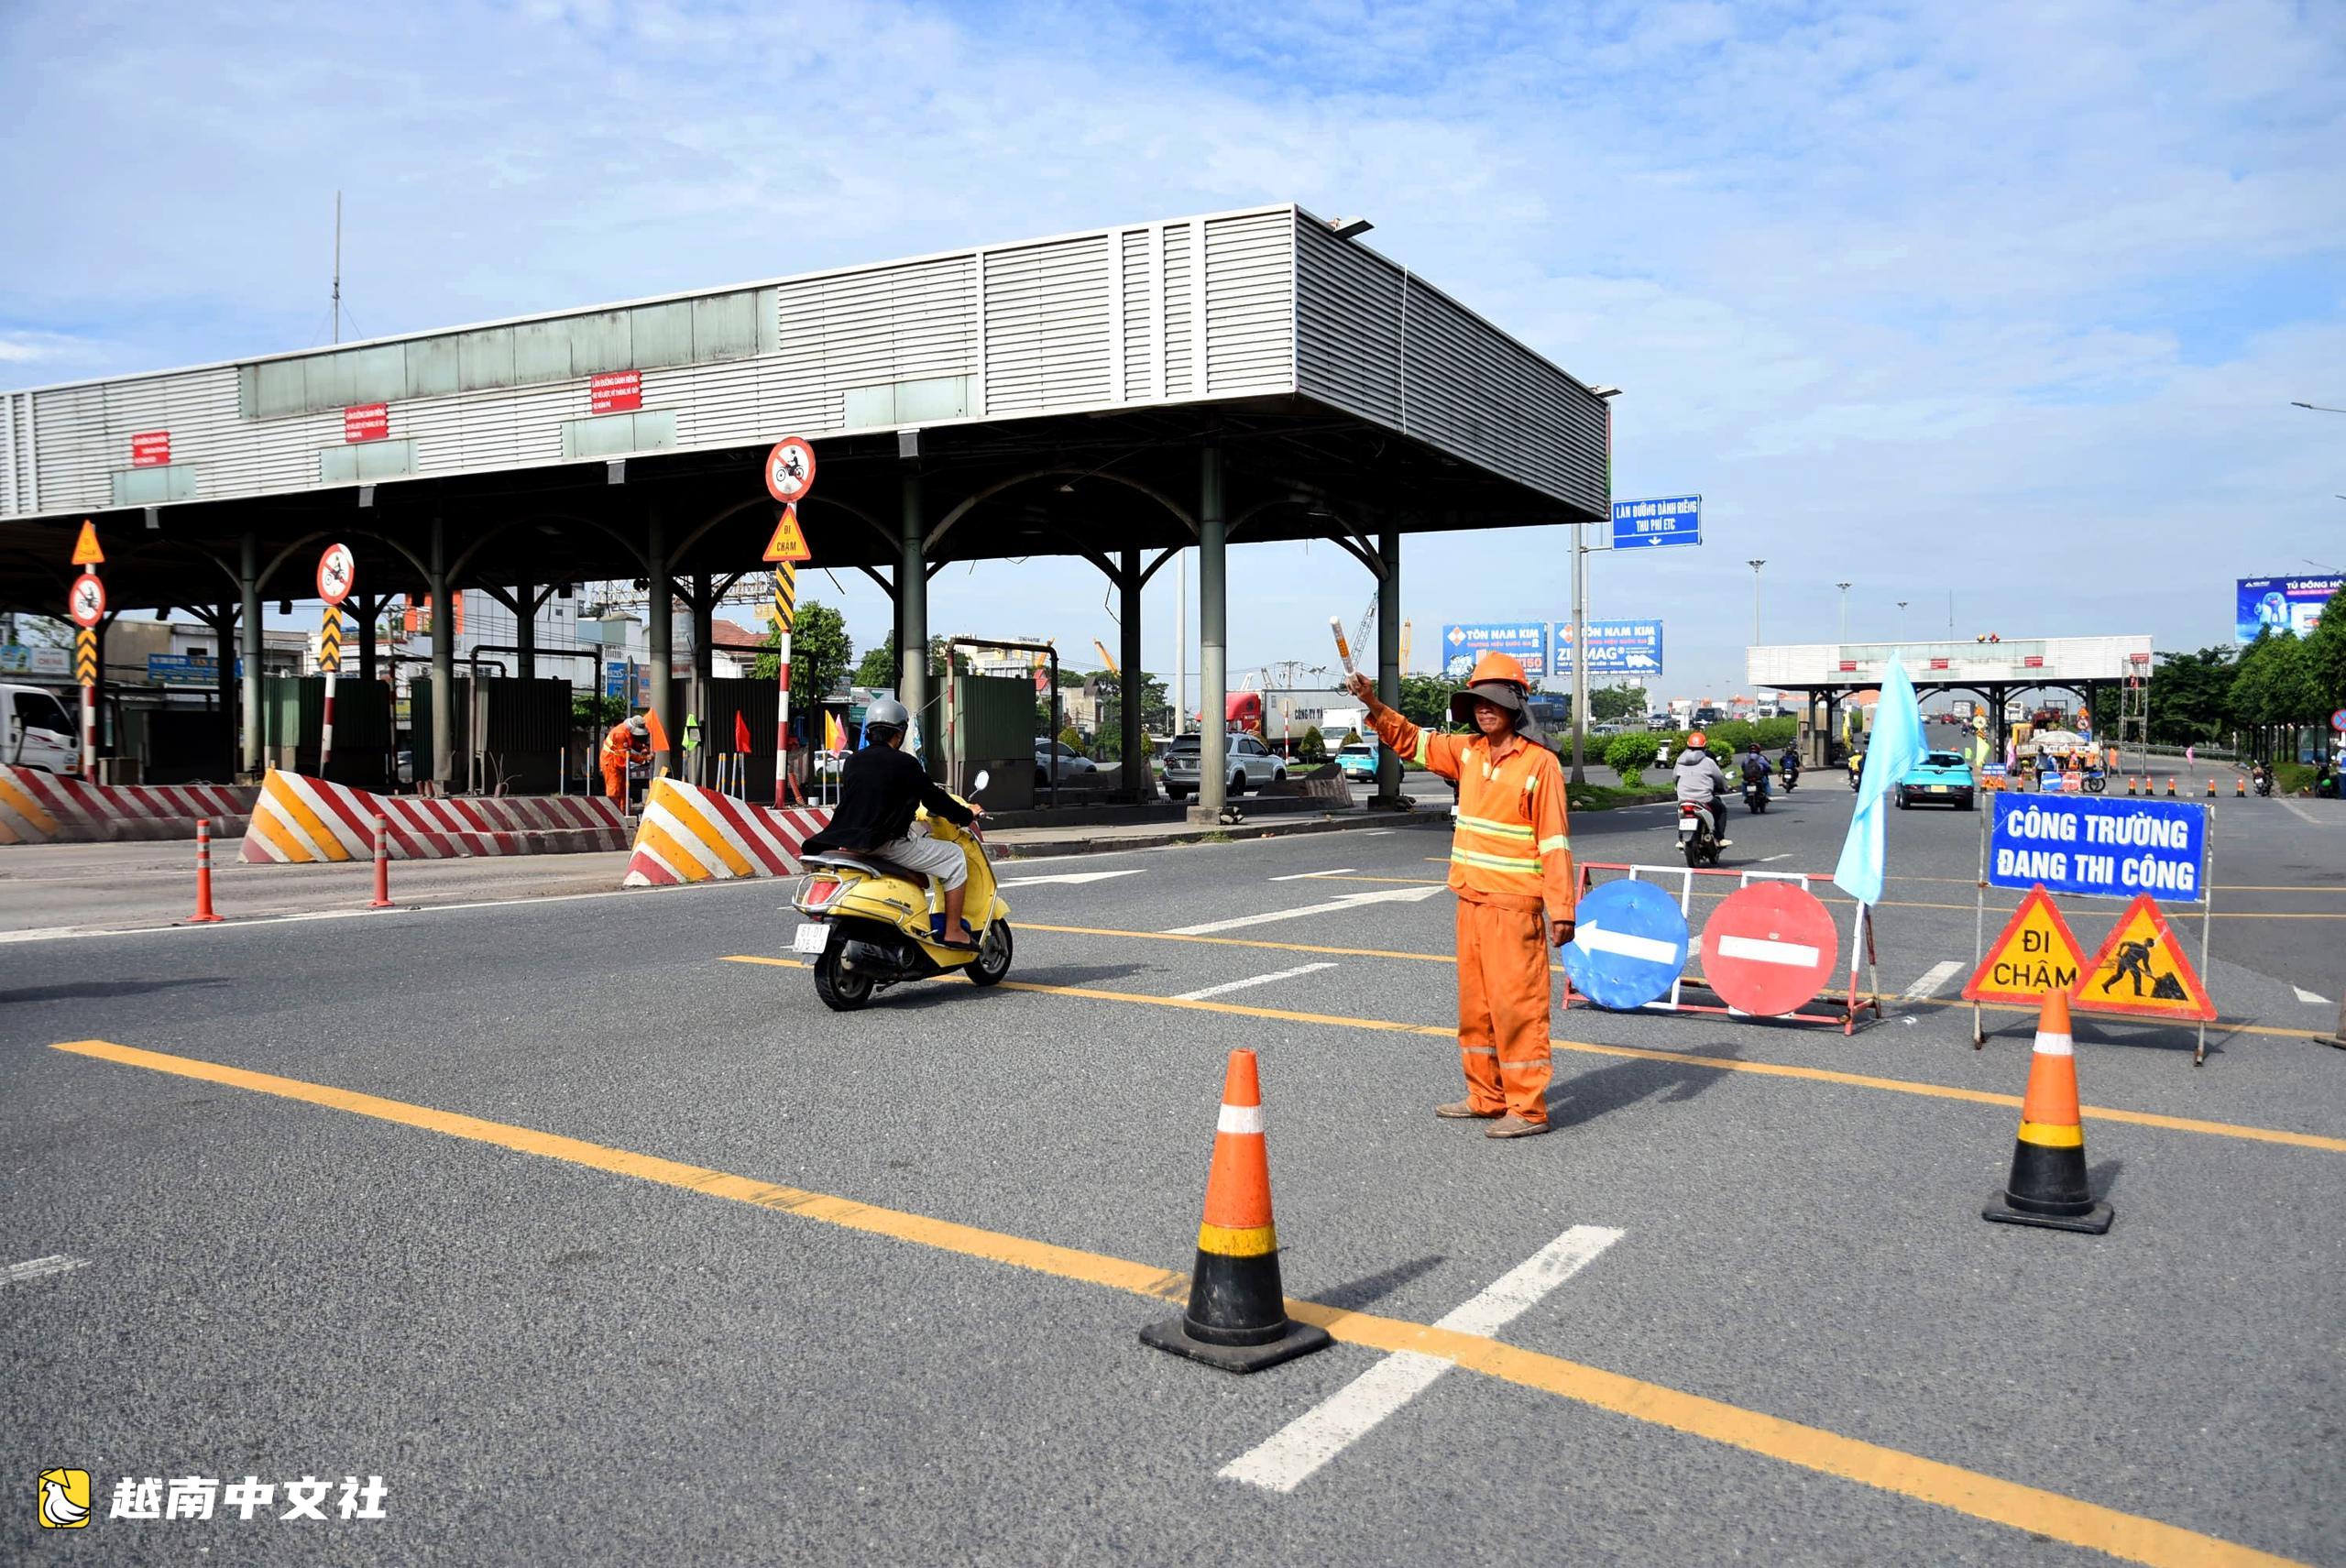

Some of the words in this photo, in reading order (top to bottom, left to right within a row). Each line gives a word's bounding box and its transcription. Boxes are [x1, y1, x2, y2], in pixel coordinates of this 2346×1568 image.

[1617, 504, 1630, 519] LÀN
[1657, 500, 1676, 515] DÀNH
[1677, 499, 1697, 514] RIÊNG
[1636, 519, 1649, 532] THU
[1650, 516, 1662, 532] PHÍ
[1663, 518, 1675, 531] ETC
[2300, 579, 2328, 589] ĐÔNG
[1466, 628, 1488, 640] TÔN
[1490, 630, 1517, 640] NAM
[1518, 629, 1540, 639] KIM
[1605, 627, 1631, 637] NAM
[1634, 626, 1655, 636] KIM
[1295, 706, 1309, 720] CÔNG
[2007, 805, 2077, 841] CÔNG
[2085, 811, 2188, 850] TRƯỜNG
[1997, 849, 2066, 881] ĐANG
[2075, 854, 2114, 884] THI
[2121, 853, 2195, 891] CÔNG
[2023, 929, 2049, 954] ĐI
[1994, 959, 2077, 993] CHẬM
